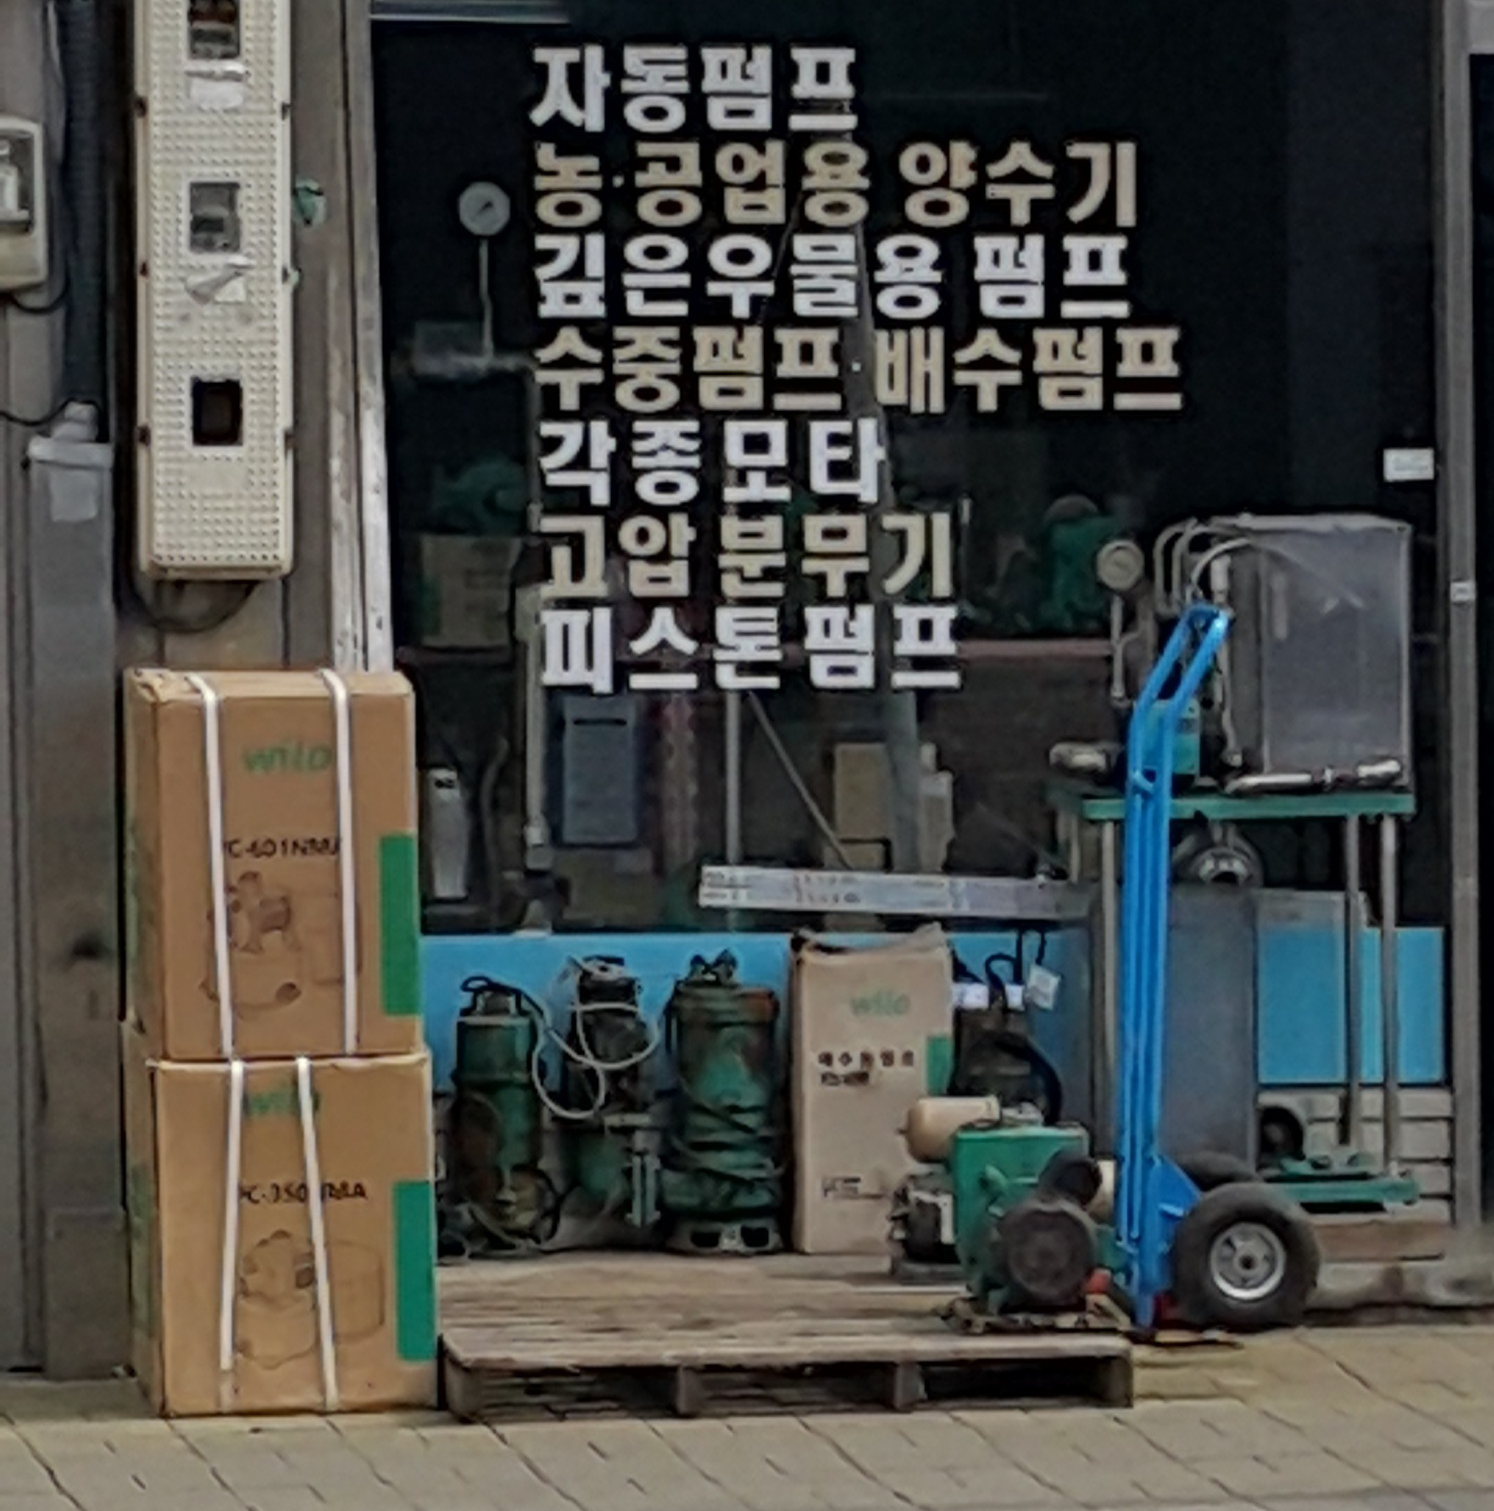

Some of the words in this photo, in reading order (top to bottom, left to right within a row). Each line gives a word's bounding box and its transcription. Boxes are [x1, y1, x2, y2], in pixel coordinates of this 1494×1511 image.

[529, 44, 860, 133] 자동펌프
[898, 139, 1138, 228] 양수기
[533, 233, 943, 319] 깊은우물용
[973, 233, 1131, 319] 펌프
[538, 419, 886, 506] 각종모타
[538, 512, 952, 600] 고압분무기
[538, 604, 962, 693] 피스톤펌프
